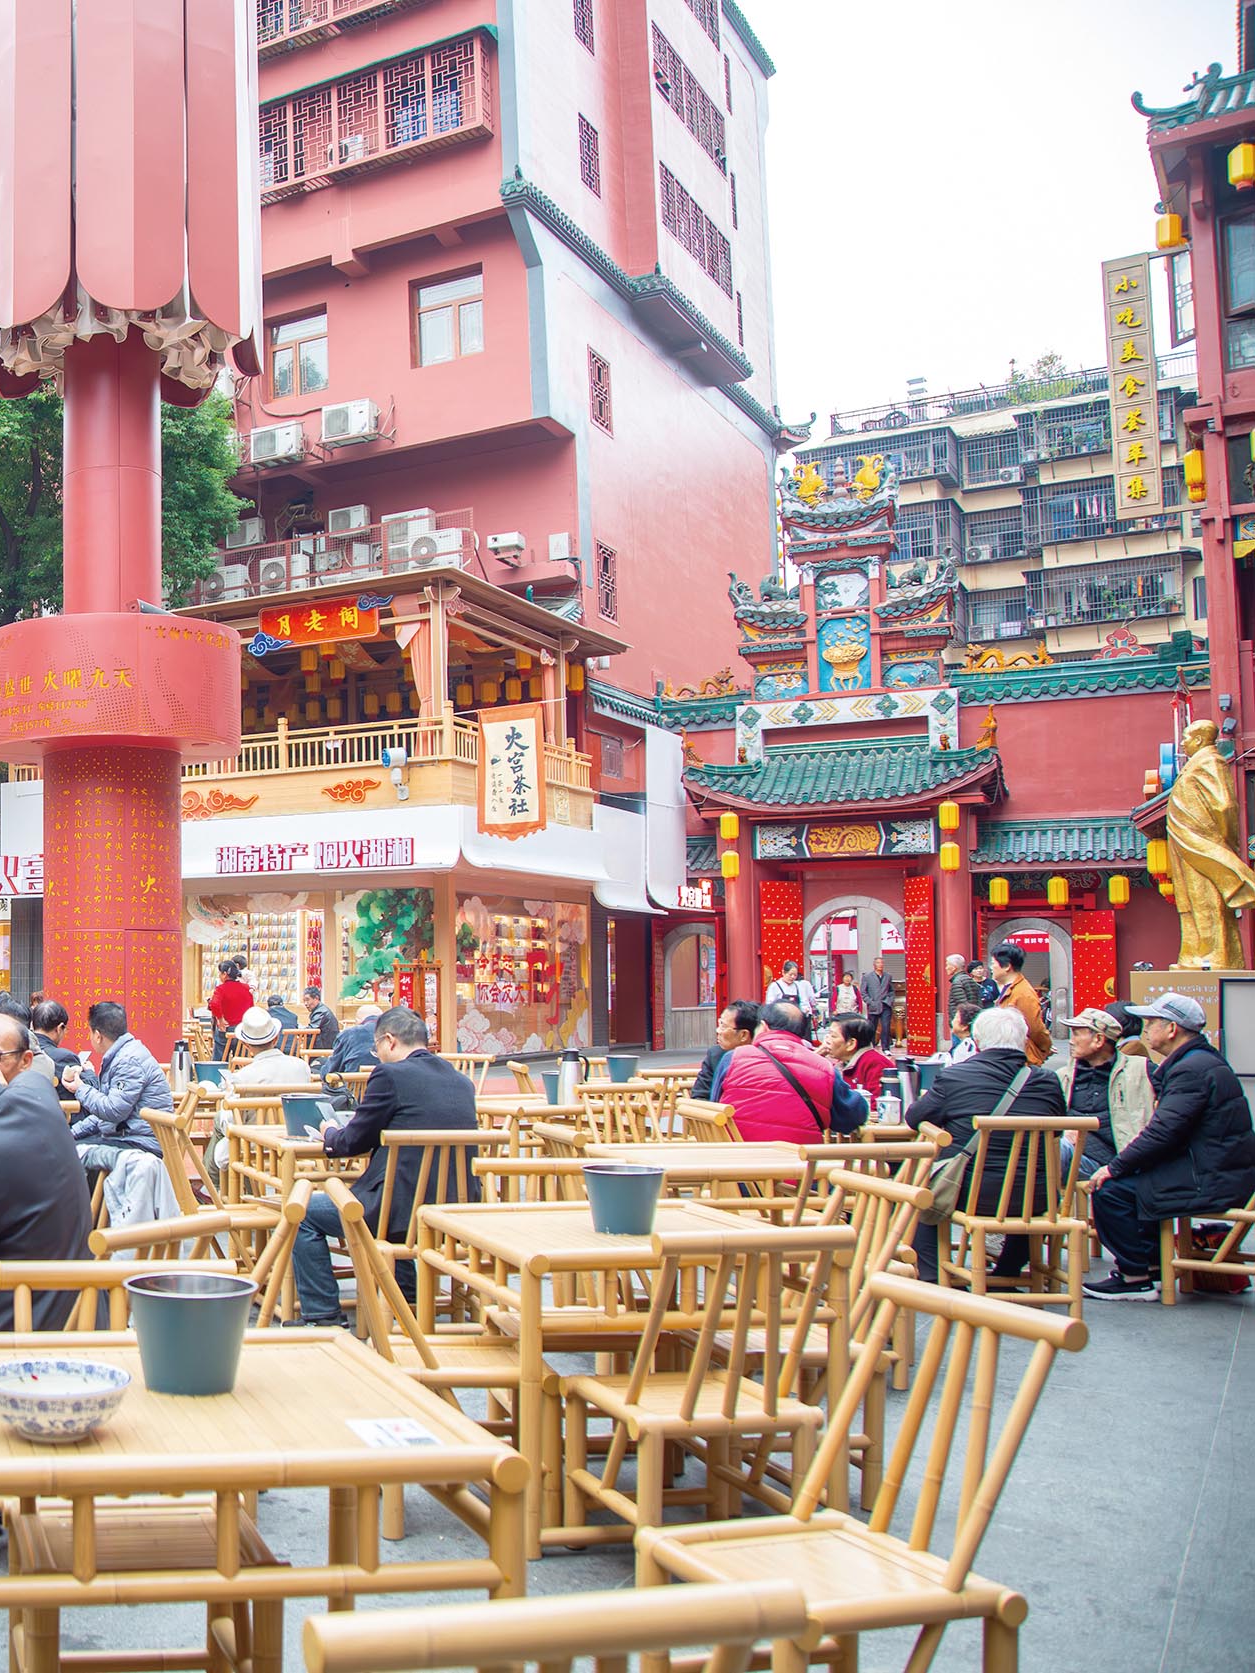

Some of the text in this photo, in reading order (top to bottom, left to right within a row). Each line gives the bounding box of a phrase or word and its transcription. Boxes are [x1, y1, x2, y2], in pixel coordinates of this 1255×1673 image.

[1114, 274, 1148, 500] 小吃美食荟萃集
[41, 667, 133, 692] 火曜九天
[216, 837, 414, 873] 湖南特产 烟火湖湘
